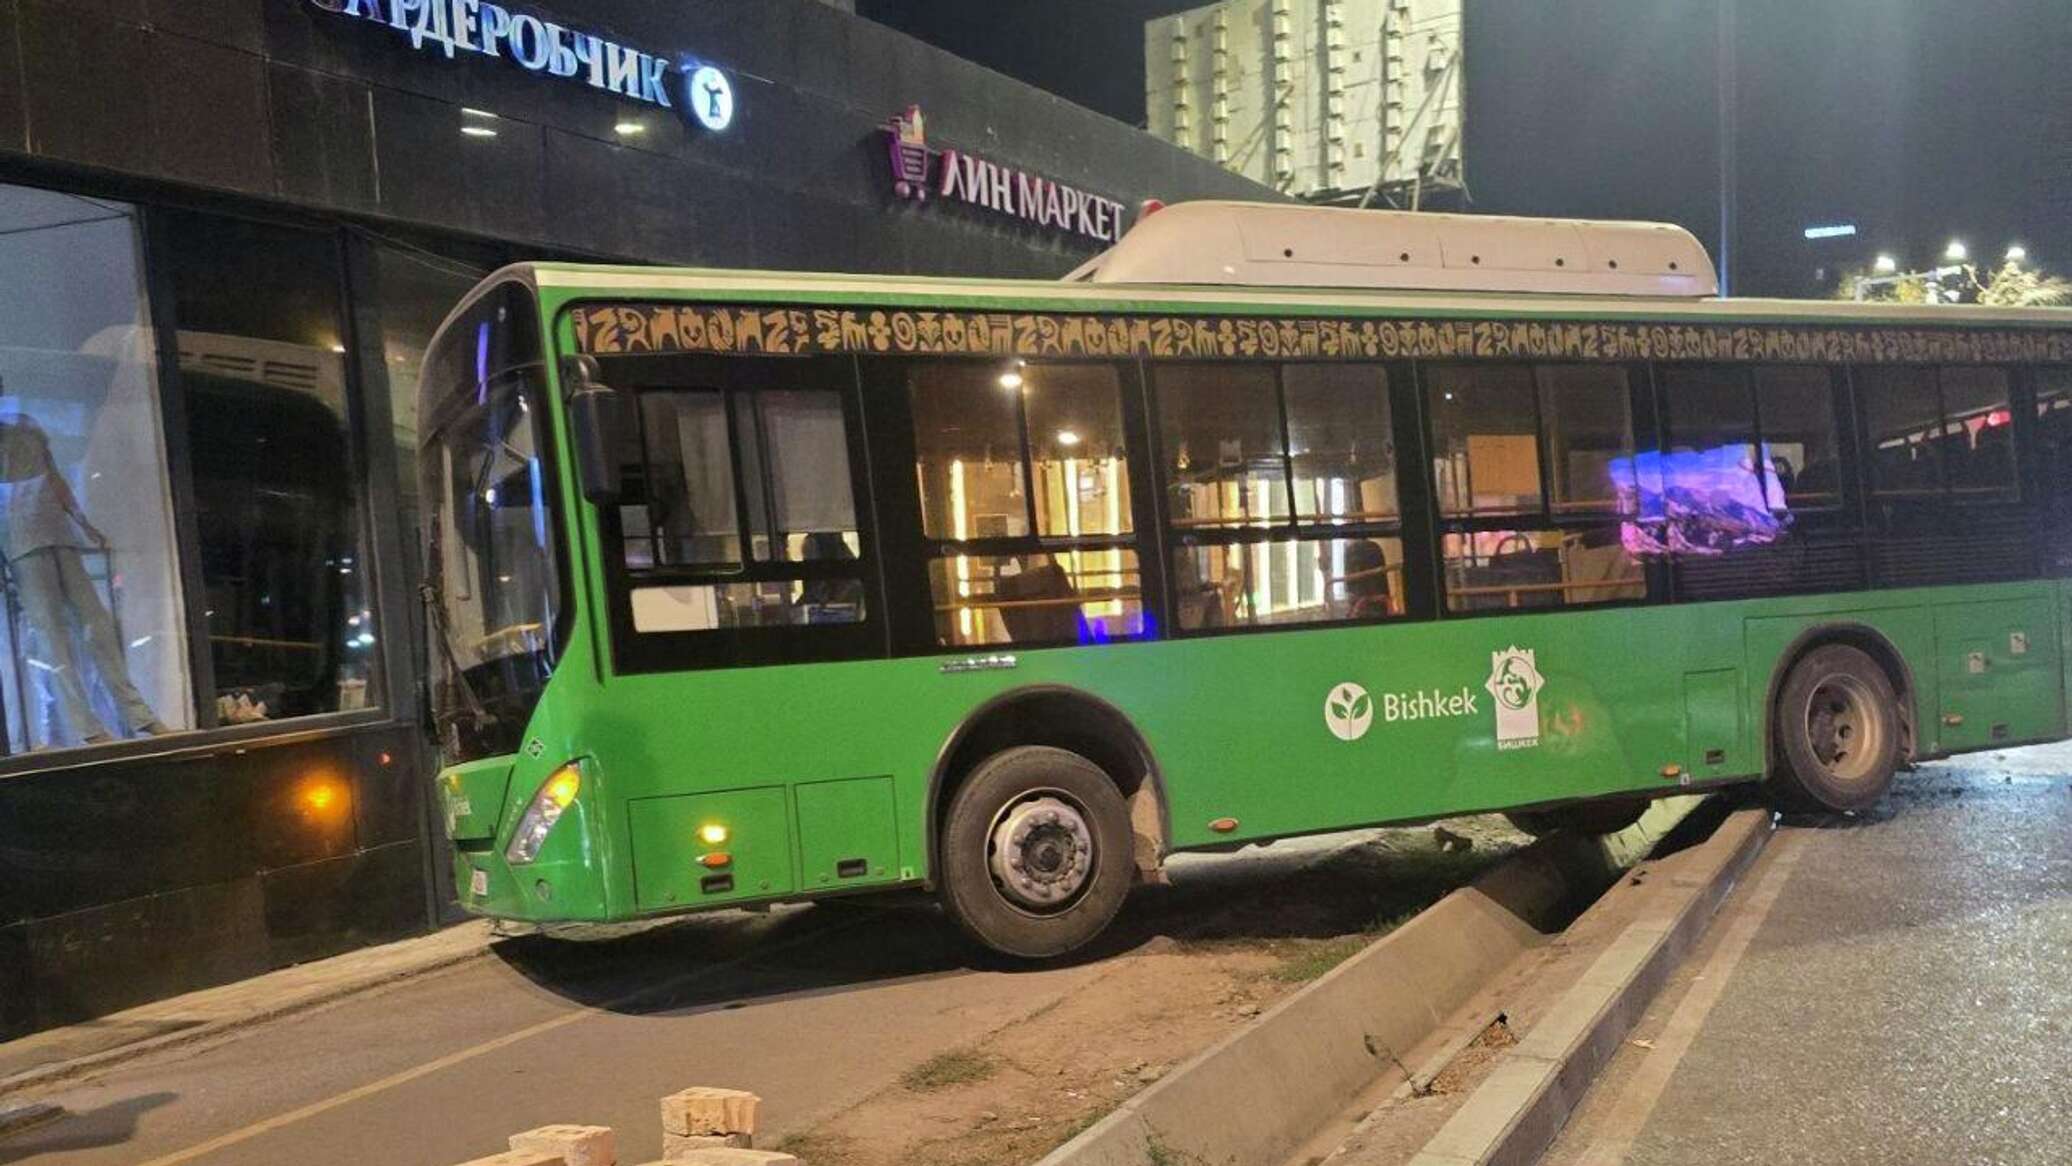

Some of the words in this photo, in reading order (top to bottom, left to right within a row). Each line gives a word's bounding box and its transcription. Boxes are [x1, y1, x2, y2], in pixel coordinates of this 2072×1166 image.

[311, 0, 672, 107] РДЕРОБЧИК
[941, 151, 1014, 215] ЛИН
[1018, 171, 1126, 242] МАРКЕТ
[1384, 687, 1478, 721] Bishkek
